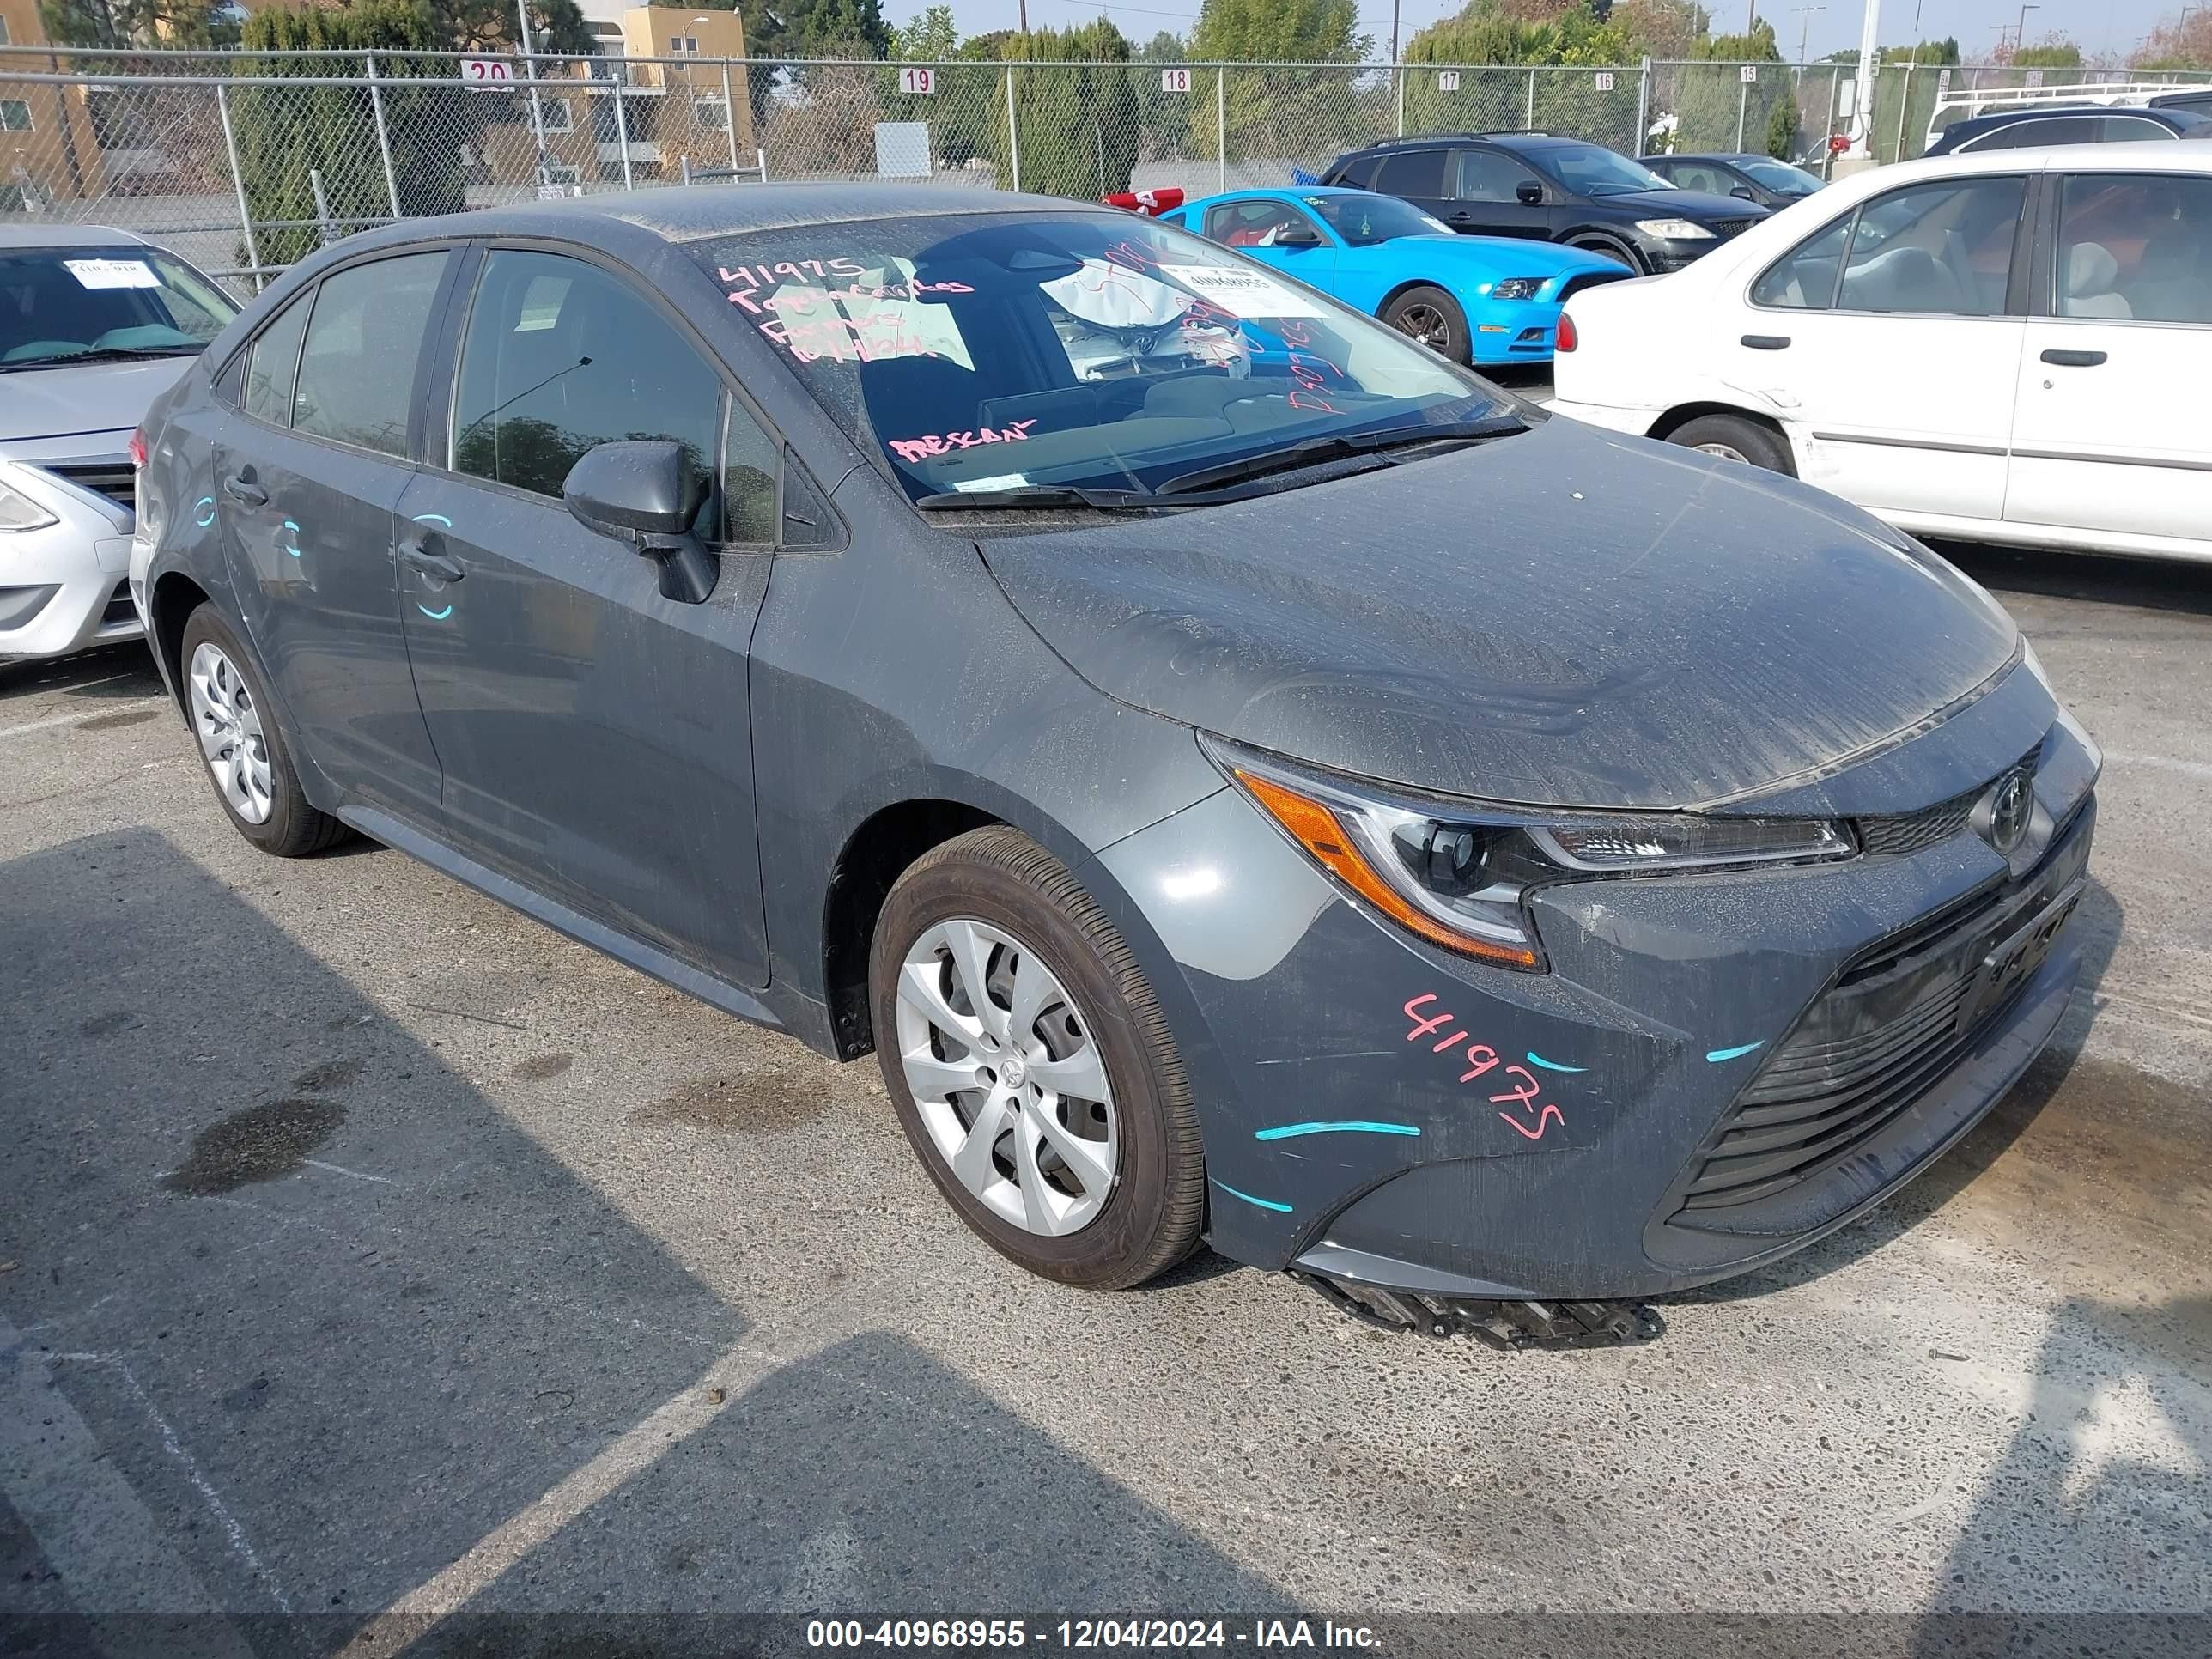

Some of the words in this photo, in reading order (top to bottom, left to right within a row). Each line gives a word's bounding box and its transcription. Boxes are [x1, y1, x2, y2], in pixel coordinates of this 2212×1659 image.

[470, 62, 507, 89] 20
[906, 70, 929, 92] 19
[1167, 70, 1186, 90] 18
[1443, 72, 1457, 90] 17
[1600, 74, 1611, 88] 16
[1744, 67, 1753, 81] 15
[718, 258, 866, 288] 41975
[1404, 994, 1565, 1139] 41975
